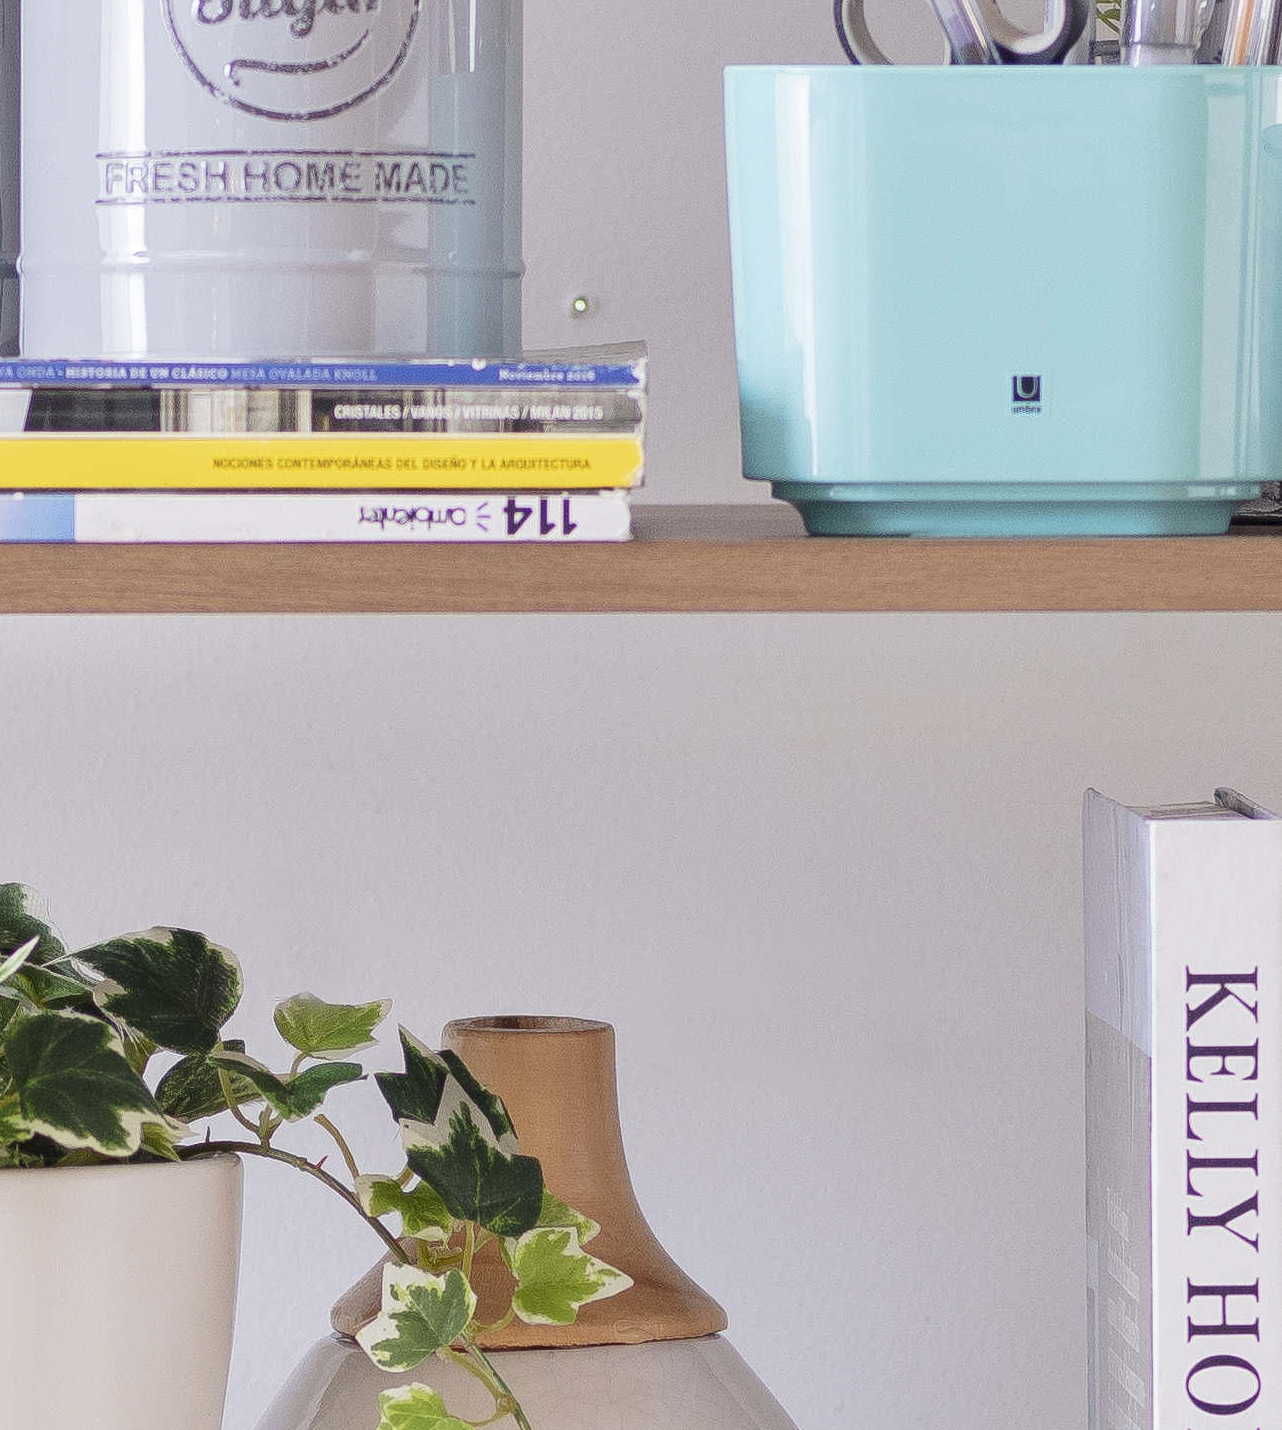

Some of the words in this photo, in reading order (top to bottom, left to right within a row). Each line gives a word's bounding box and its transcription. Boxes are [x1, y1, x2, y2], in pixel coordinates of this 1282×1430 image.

[104, 160, 229, 195] FRESH
[243, 160, 362, 194] HOME
[374, 162, 469, 195] MADE
[65, 365, 127, 380] HISTORIA
[130, 366, 148, 379] DE
[172, 363, 228, 380] CLÁSICO
[334, 366, 378, 381] KNOLL
[334, 404, 399, 420] CRISTALES
[213, 457, 273, 470] NOCIONES
[277, 455, 392, 470] CONTEMPORÁNEAS
[396, 457, 418, 470] DEL
[422, 454, 467, 470] DISEÑO
[481, 457, 497, 470] LA
[500, 457, 591, 470] ARQUITECTURA
[498, 496, 582, 538] 114
[1185, 966, 1259, 1251] KELLY
